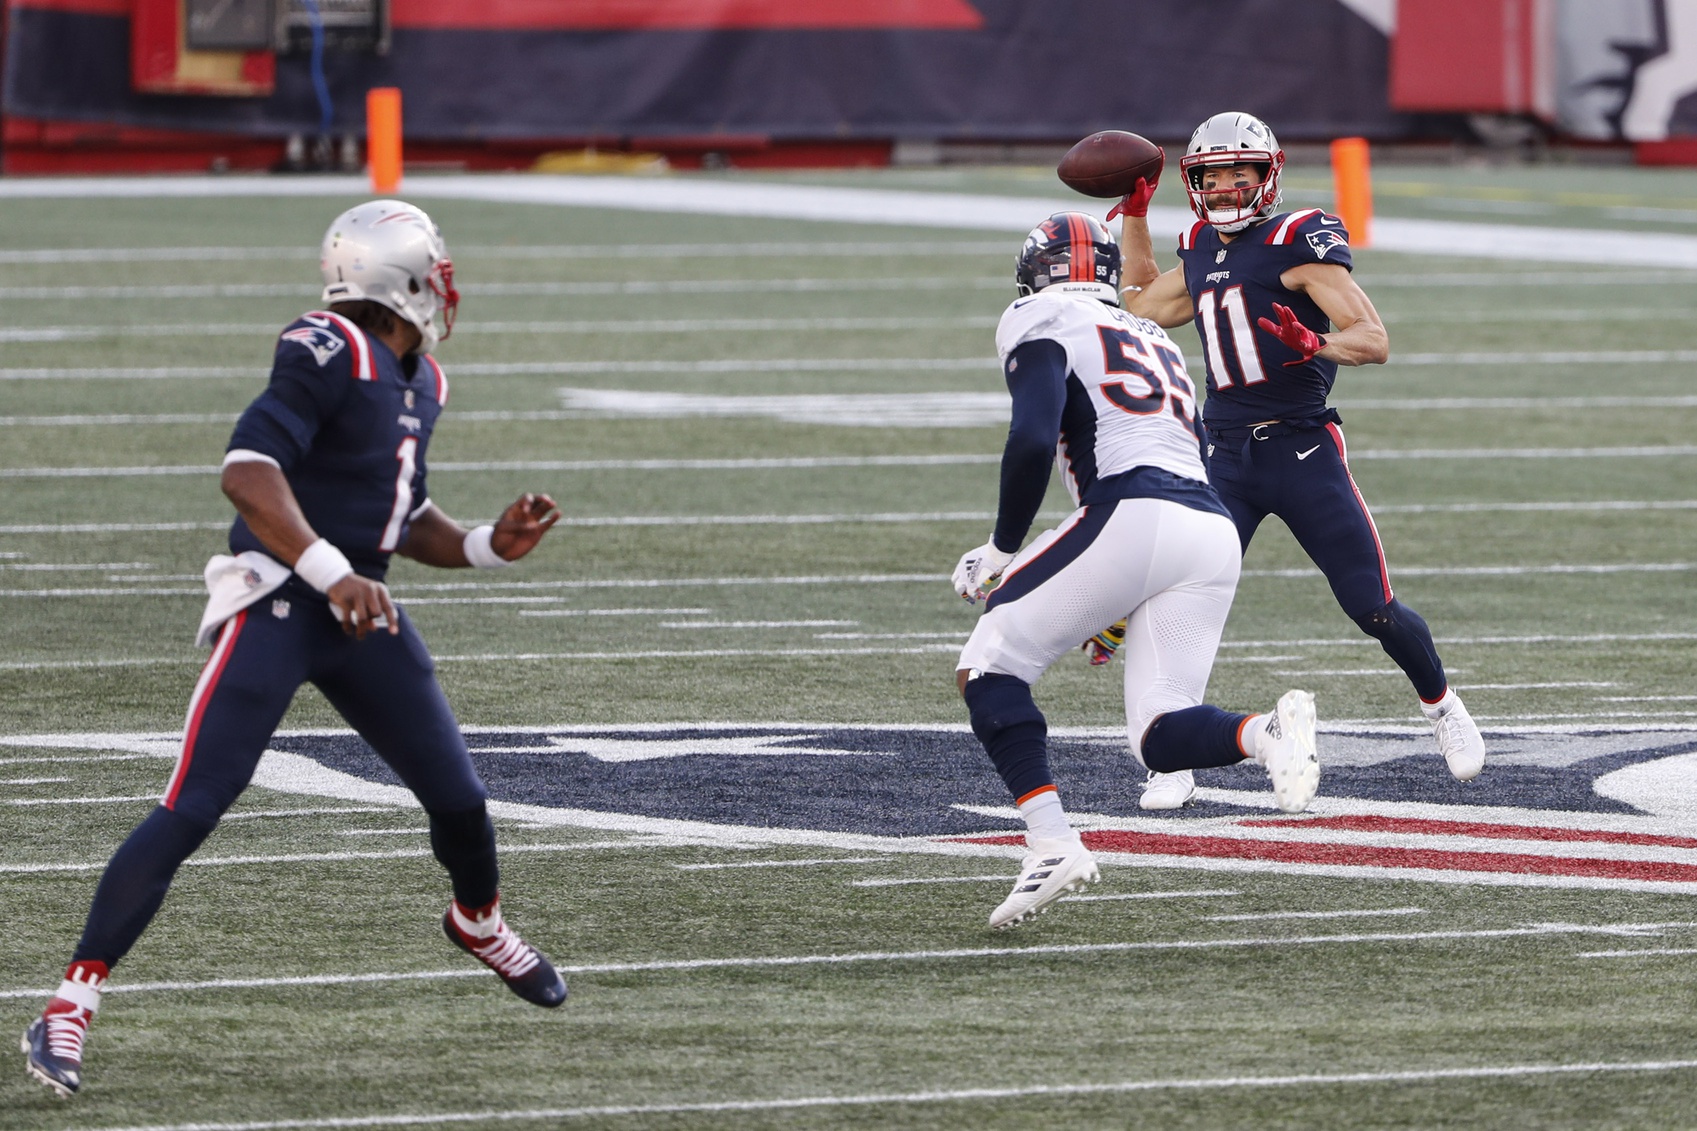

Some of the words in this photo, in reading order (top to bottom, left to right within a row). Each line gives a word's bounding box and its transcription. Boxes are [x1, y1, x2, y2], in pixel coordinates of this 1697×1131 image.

[1096, 264, 1107, 277] 55
[1205, 271, 1230, 284] PATRIOTS
[1096, 324, 1199, 441] 55
[1198, 283, 1268, 391] 11
[378, 435, 418, 552] 1
